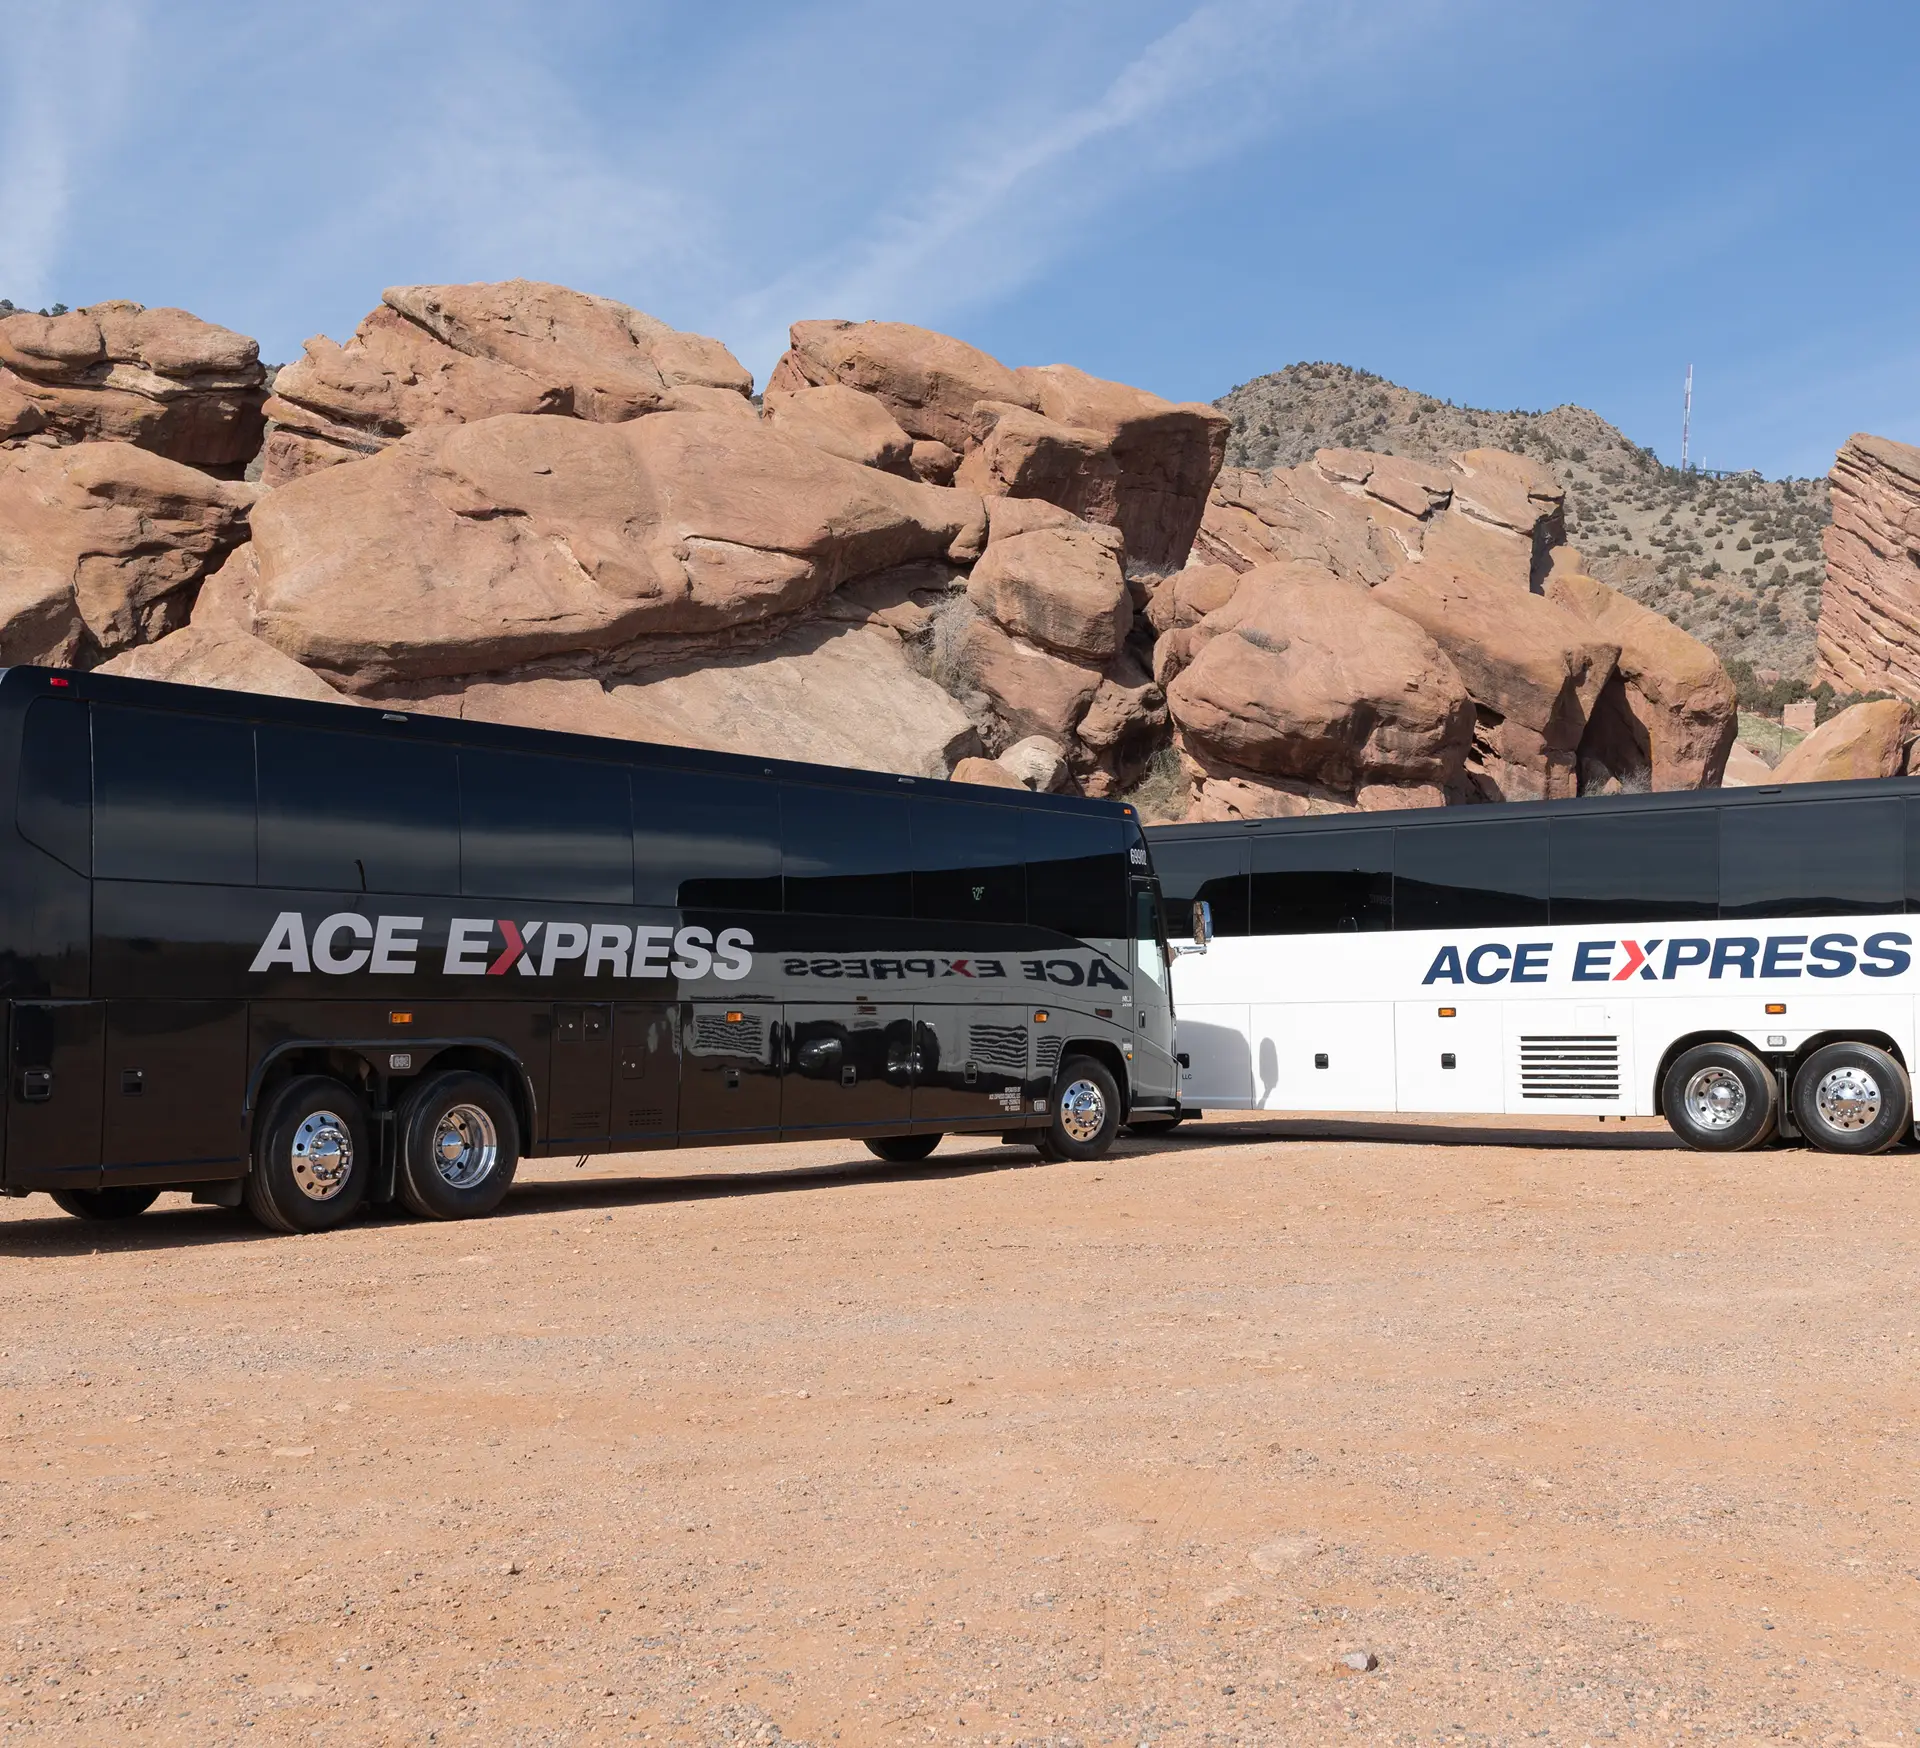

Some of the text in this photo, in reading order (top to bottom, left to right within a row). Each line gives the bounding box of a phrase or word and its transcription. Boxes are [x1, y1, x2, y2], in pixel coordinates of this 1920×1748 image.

[249, 912, 753, 981] ACE EXPRESS
[1422, 931, 1913, 984] ACE EXPRESS
